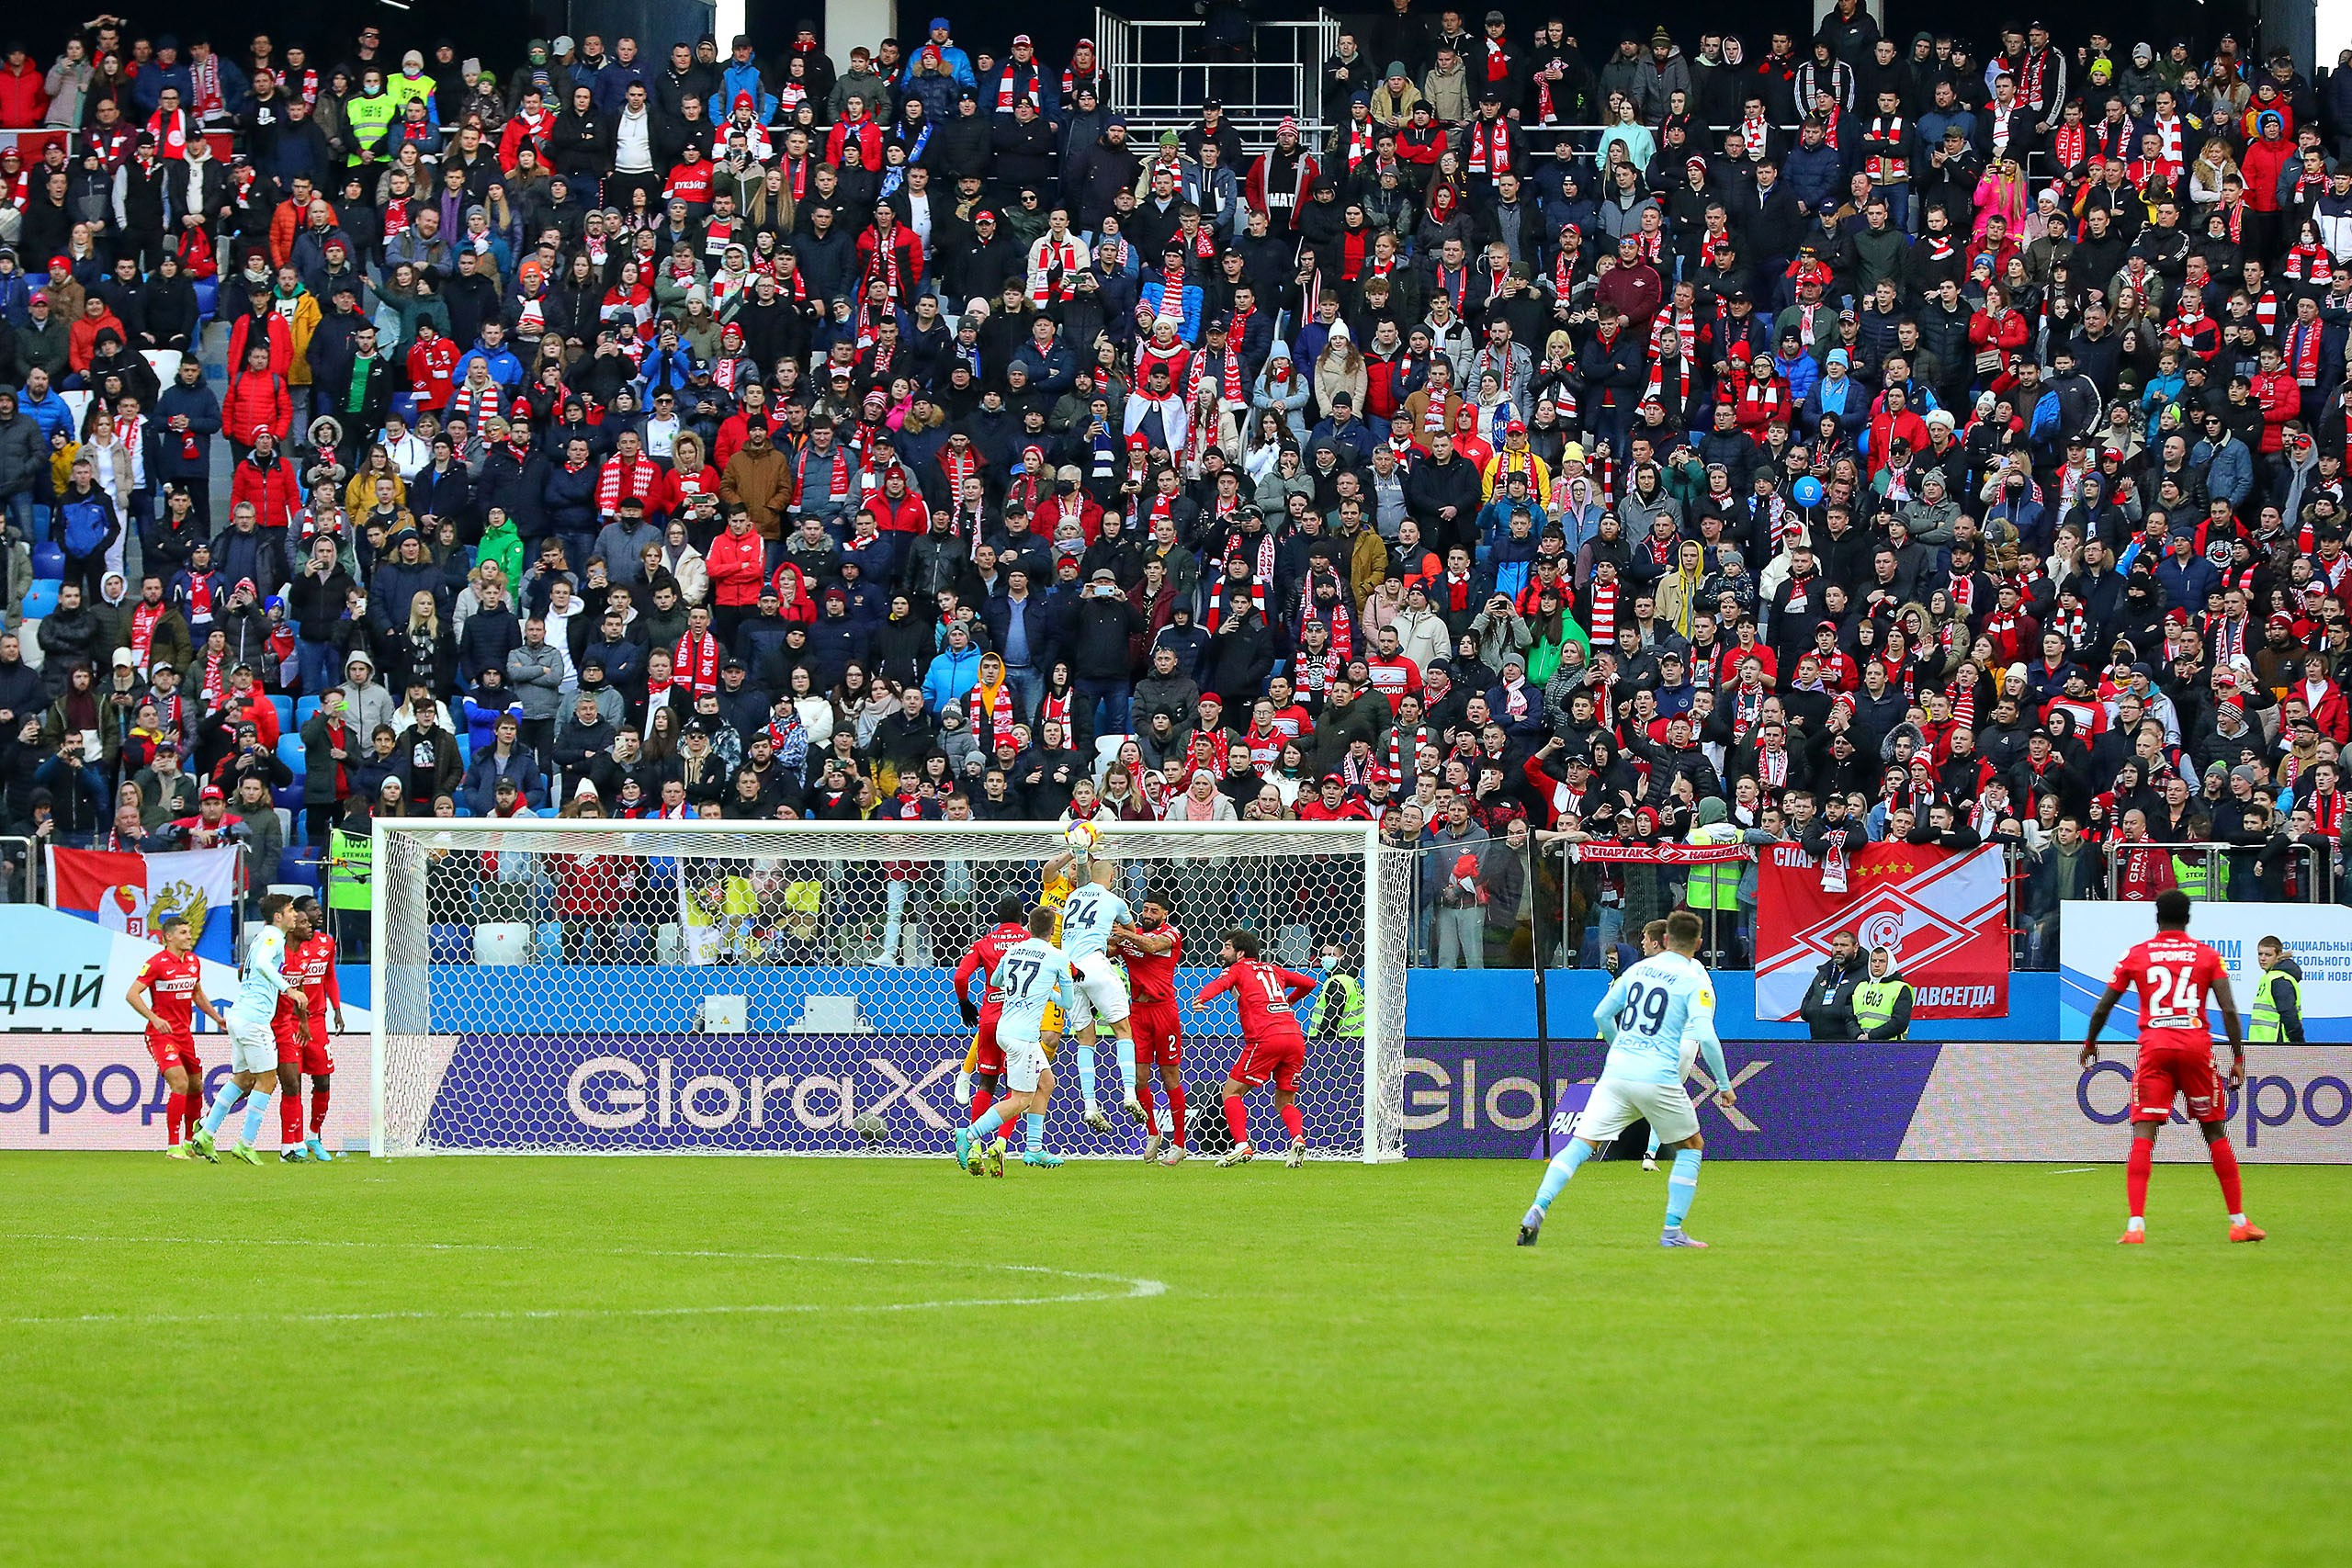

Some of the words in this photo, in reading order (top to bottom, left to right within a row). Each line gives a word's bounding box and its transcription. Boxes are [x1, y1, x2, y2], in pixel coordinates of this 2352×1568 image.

[1591, 847, 1645, 859] СПАРТАК
[1064, 898, 1100, 931] 24
[991, 932, 1024, 941] NISSAN
[2282, 941, 2352, 953] ФИЦИАЛЬНЫ
[2149, 951, 2198, 964] ПРОМЕС
[1002, 958, 1041, 999] 37
[1256, 974, 1286, 1002] 14
[2301, 970, 2324, 981] НИЙ
[2146, 965, 2200, 1017] 24
[1622, 982, 1670, 1037] 89
[1168, 1034, 1177, 1053] 2
[567, 1055, 964, 1130] GloraX
[2076, 1060, 2352, 1147] Сро
